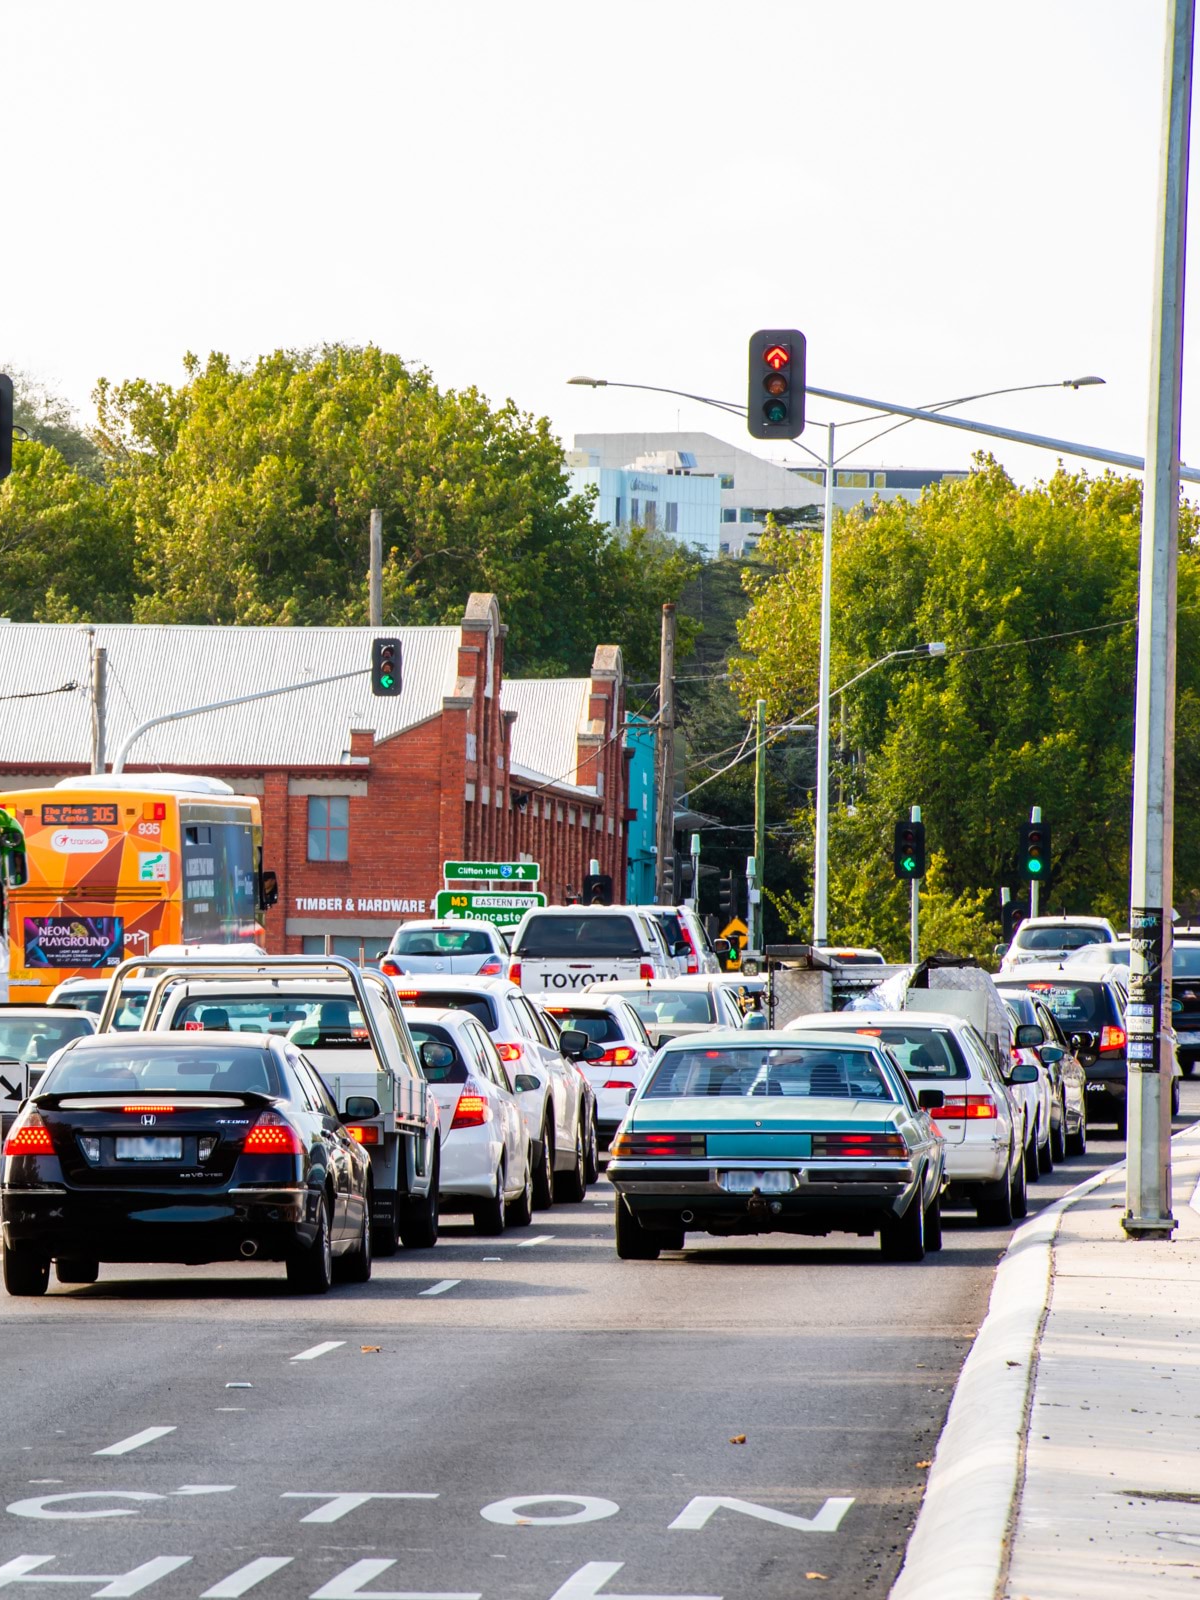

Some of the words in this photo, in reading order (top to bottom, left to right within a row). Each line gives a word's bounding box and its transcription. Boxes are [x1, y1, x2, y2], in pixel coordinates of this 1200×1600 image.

[44, 806, 60, 815] The
[62, 806, 87, 815] Pines
[92, 806, 115, 822] 305
[61, 815, 90, 823] Centre
[138, 823, 160, 835] 935
[70, 837, 104, 845] transdev
[457, 867, 483, 875] Clifton
[485, 867, 498, 875] Hill
[501, 866, 512, 874] 29
[295, 897, 342, 911] TIMBER
[345, 898, 355, 911] &
[357, 898, 425, 913] HARDWARE
[451, 896, 468, 907] M3
[475, 898, 512, 907] EASTERN
[515, 898, 535, 906] FWY
[464, 910, 524, 922] Doncaste
[38, 926, 70, 936] NEON
[38, 936, 110, 947] PLAYGROUND
